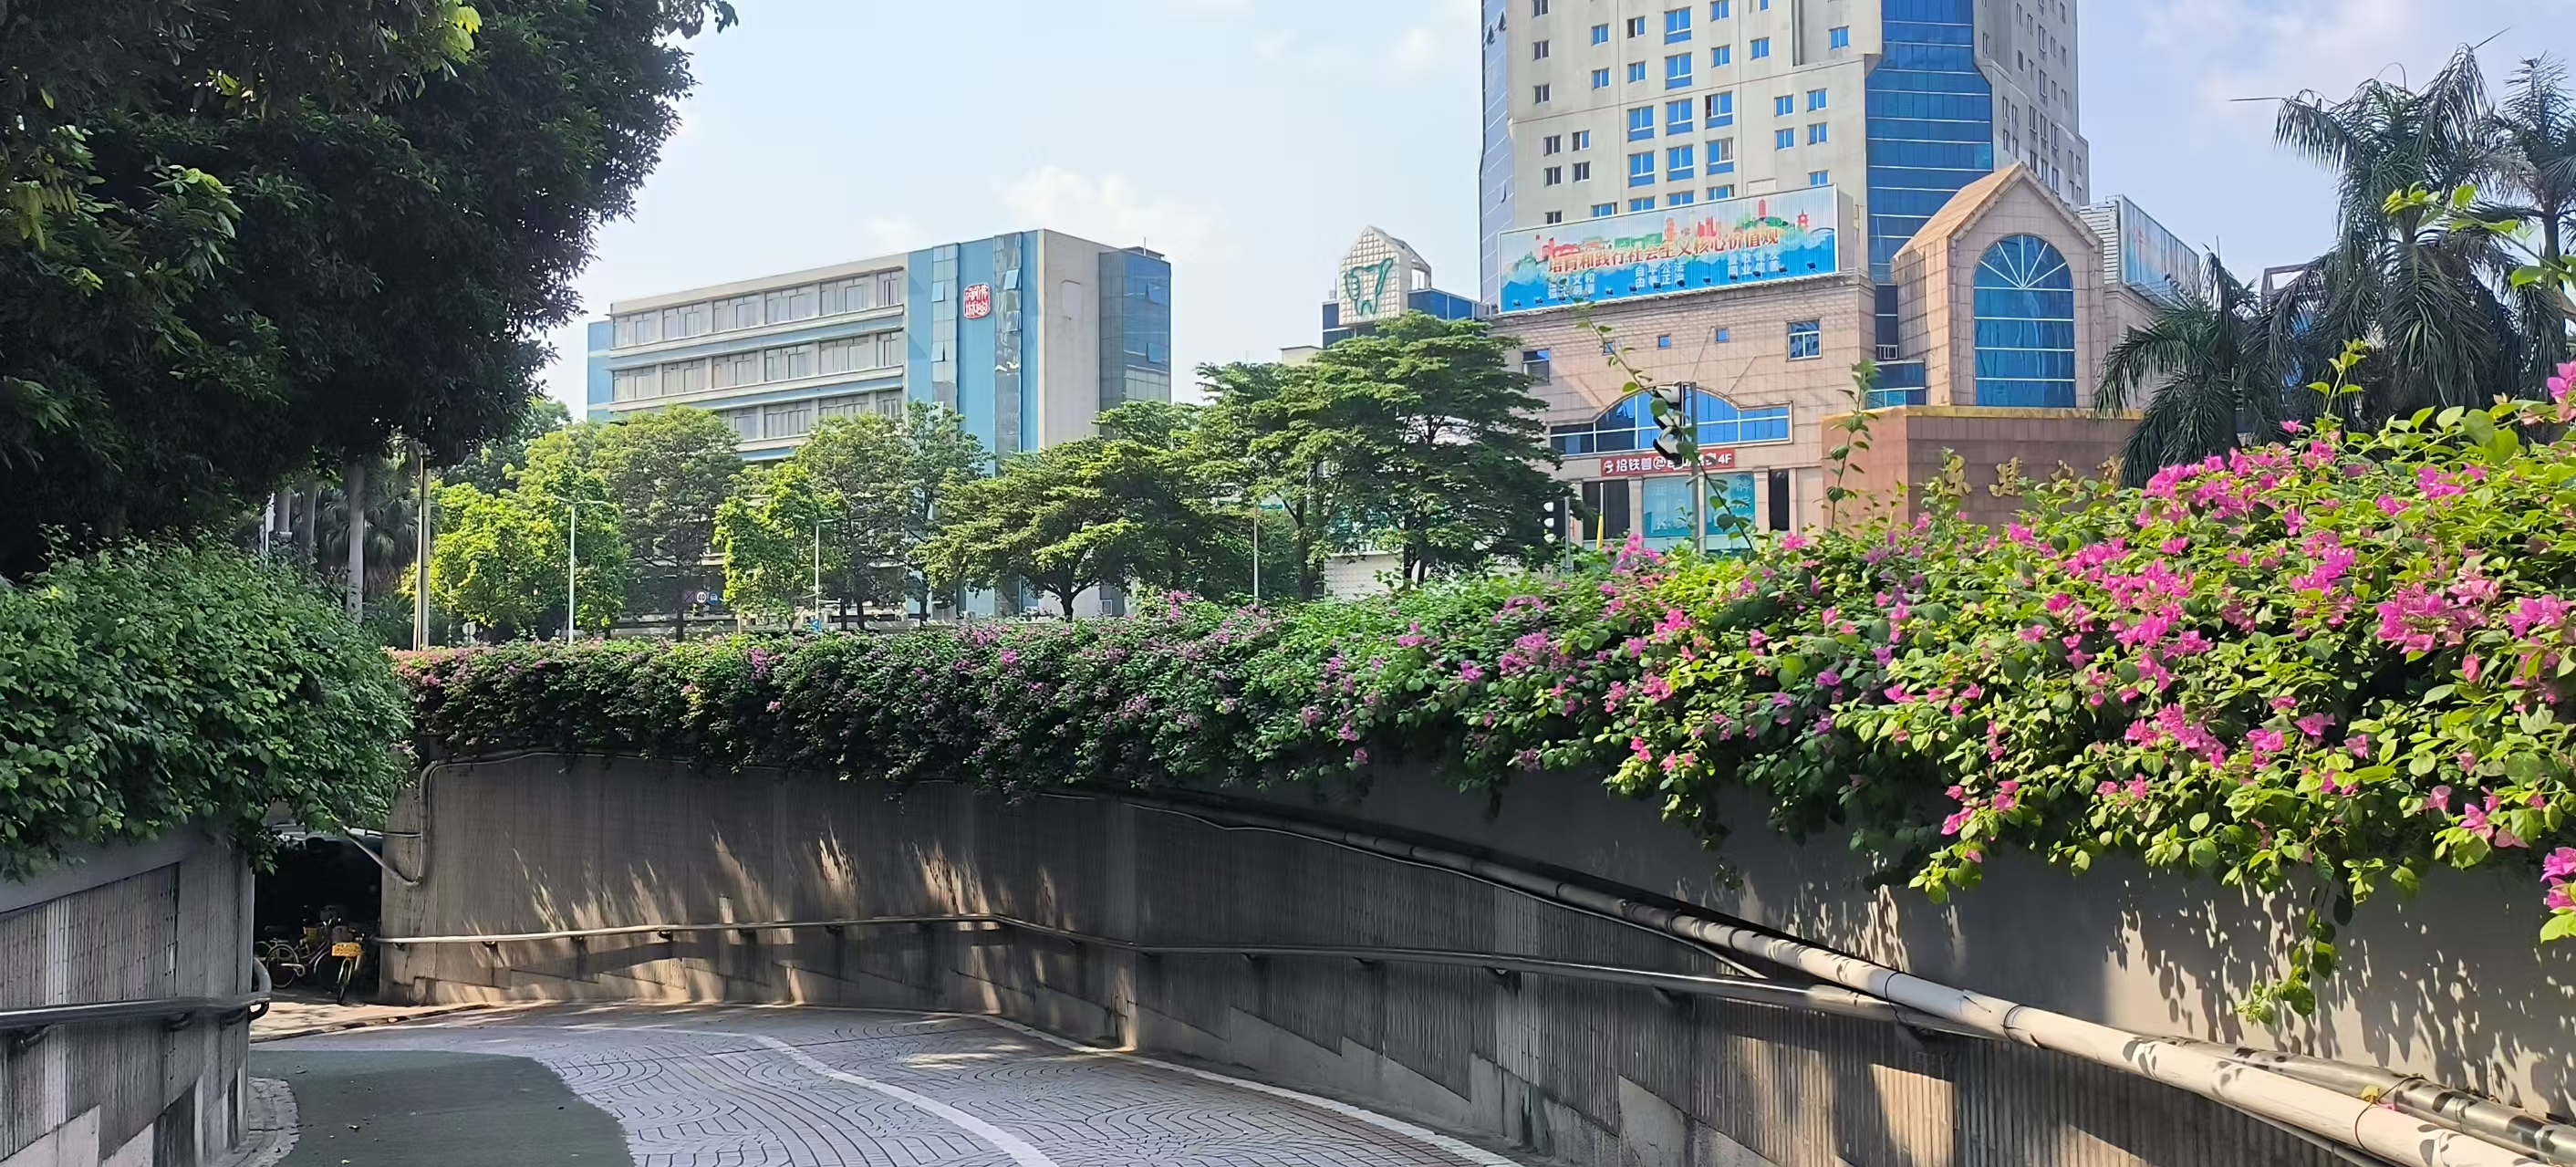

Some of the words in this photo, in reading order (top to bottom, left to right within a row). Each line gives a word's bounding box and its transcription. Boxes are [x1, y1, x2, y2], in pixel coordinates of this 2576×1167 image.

[1549, 230, 1779, 273] 培育和践行社会主义核心价值观
[1718, 453, 1732, 464] 4F
